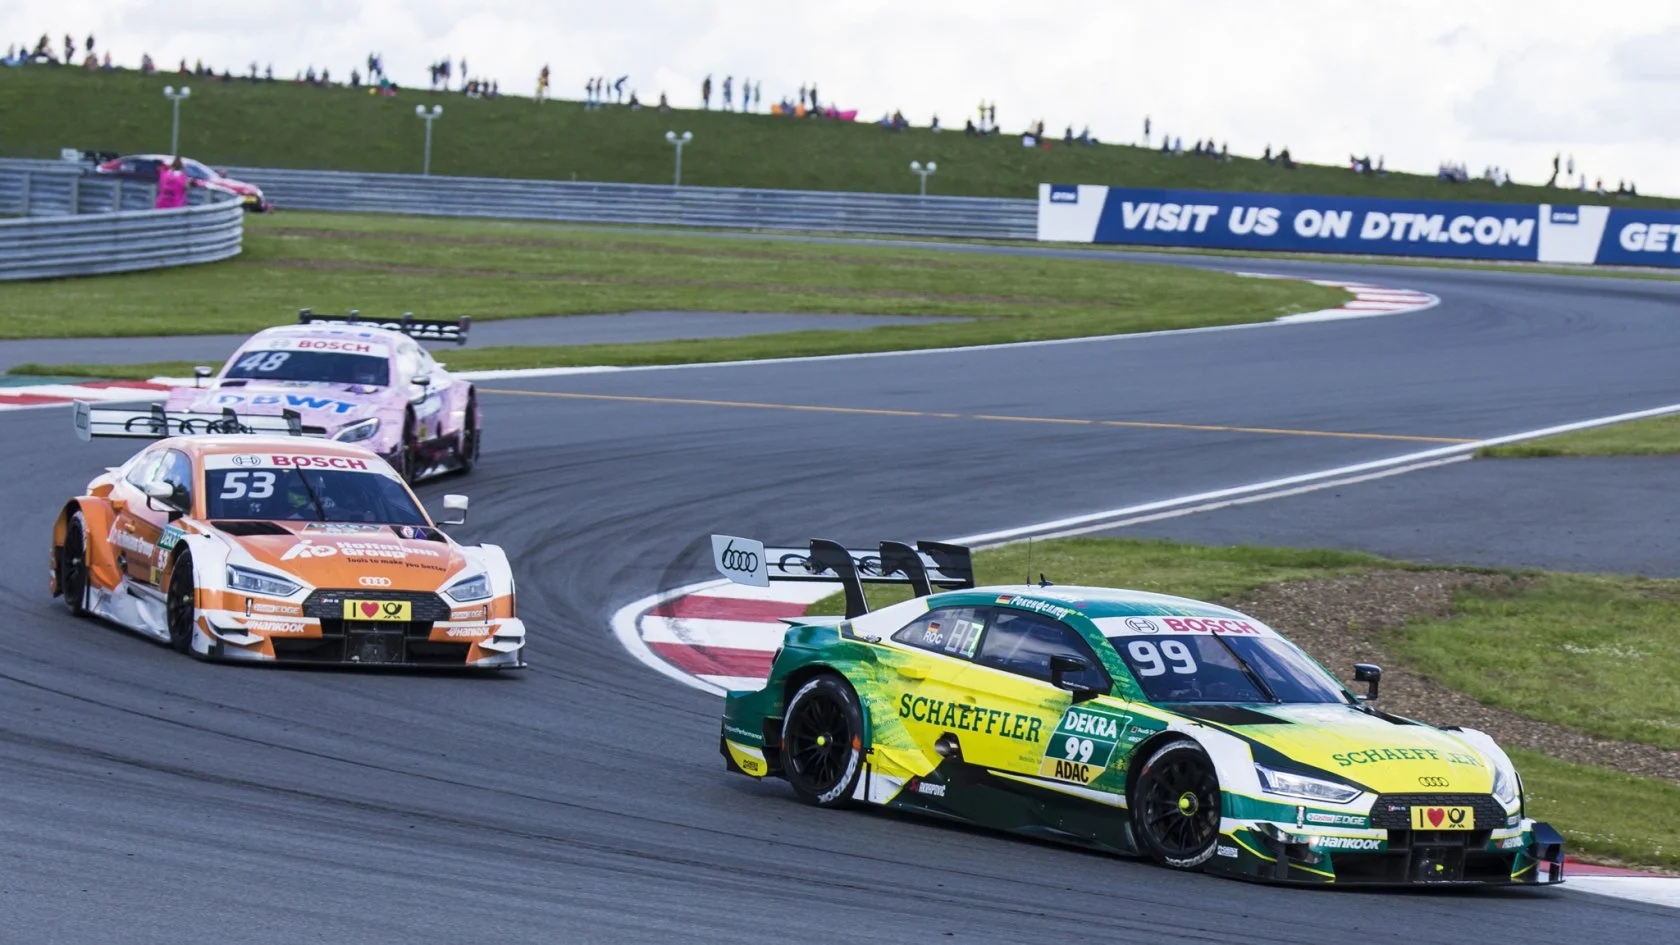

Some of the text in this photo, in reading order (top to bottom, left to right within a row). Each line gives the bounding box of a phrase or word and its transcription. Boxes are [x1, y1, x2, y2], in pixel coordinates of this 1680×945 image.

[1121, 201, 1535, 246] VISIT US ON DTM.COM
[298, 339, 370, 352] BOSCH
[237, 351, 291, 372] 48
[271, 455, 368, 470] BOSCH
[219, 471, 276, 500] 53
[341, 548, 406, 559] Group
[1162, 618, 1261, 635] BOSCH
[923, 631, 944, 645] ROC
[1127, 640, 1198, 677] 99
[899, 693, 1042, 743] SCHAEFFLER
[1064, 711, 1117, 738] DEKRA
[1065, 736, 1094, 763] 99
[1332, 748, 1485, 768] SCHAEFFER
[1055, 760, 1090, 784] ADAC
[1336, 815, 1368, 826] EDGE
